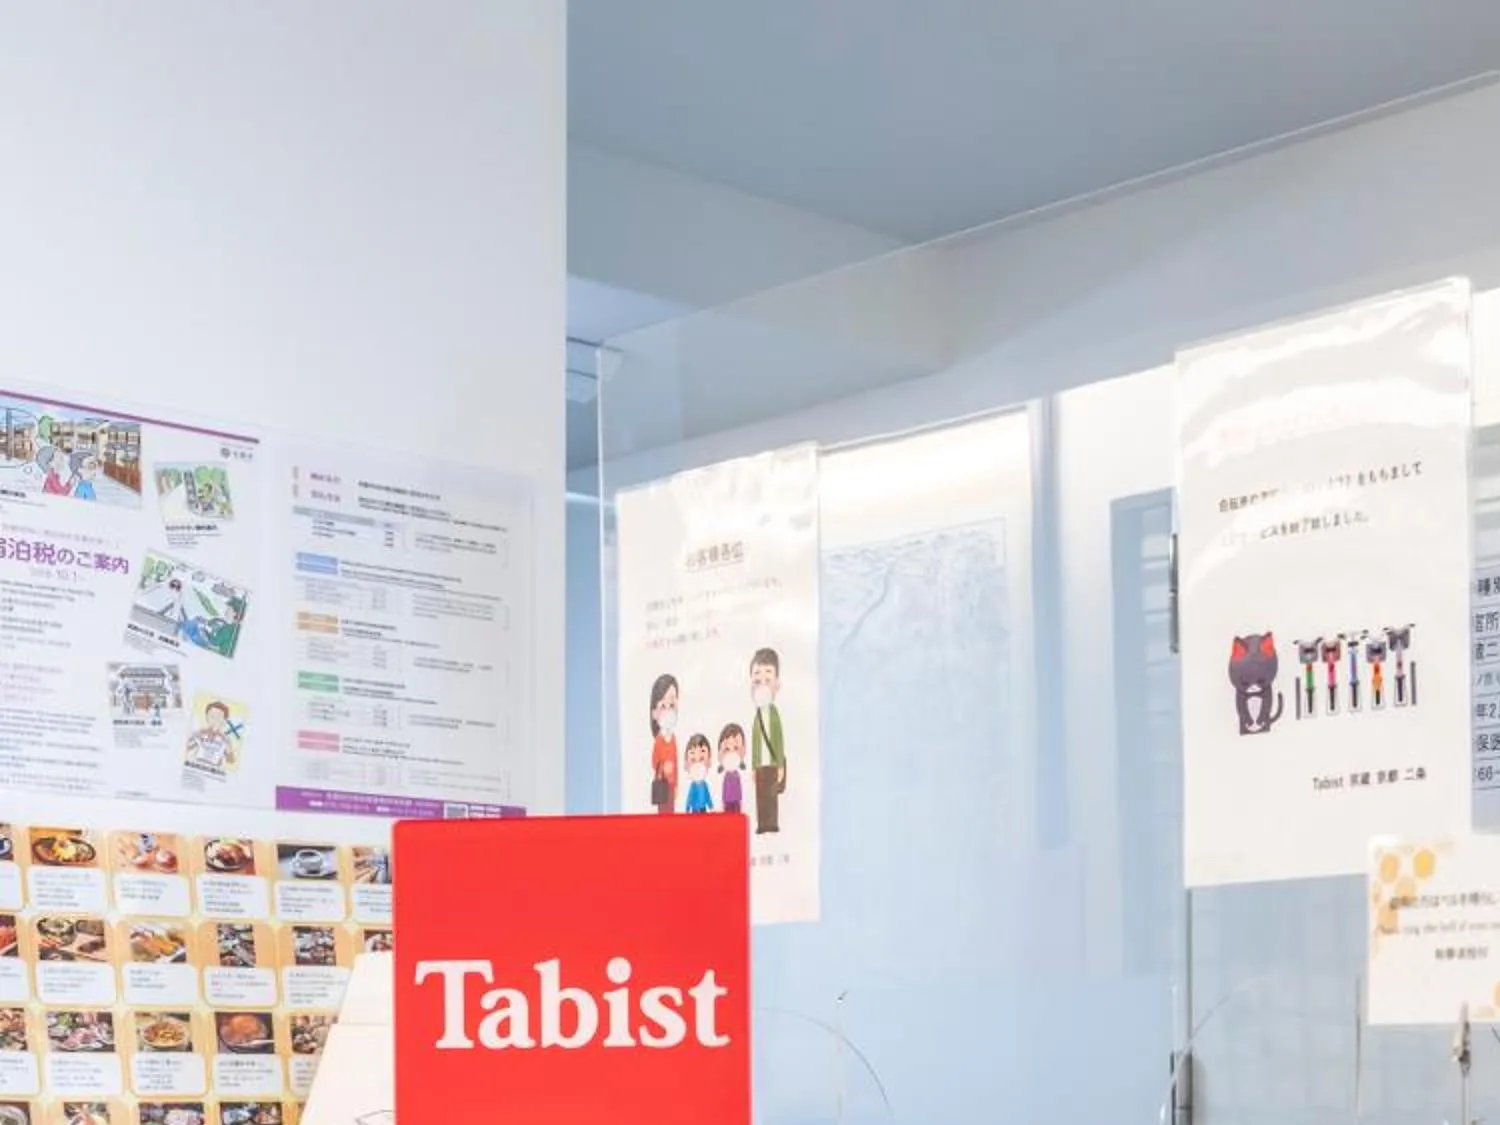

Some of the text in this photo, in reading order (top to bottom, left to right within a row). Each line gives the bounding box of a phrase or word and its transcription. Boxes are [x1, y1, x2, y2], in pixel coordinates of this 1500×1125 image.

[0, 537, 129, 575] 泊税のご案内
[414, 956, 731, 1049] Tabist
